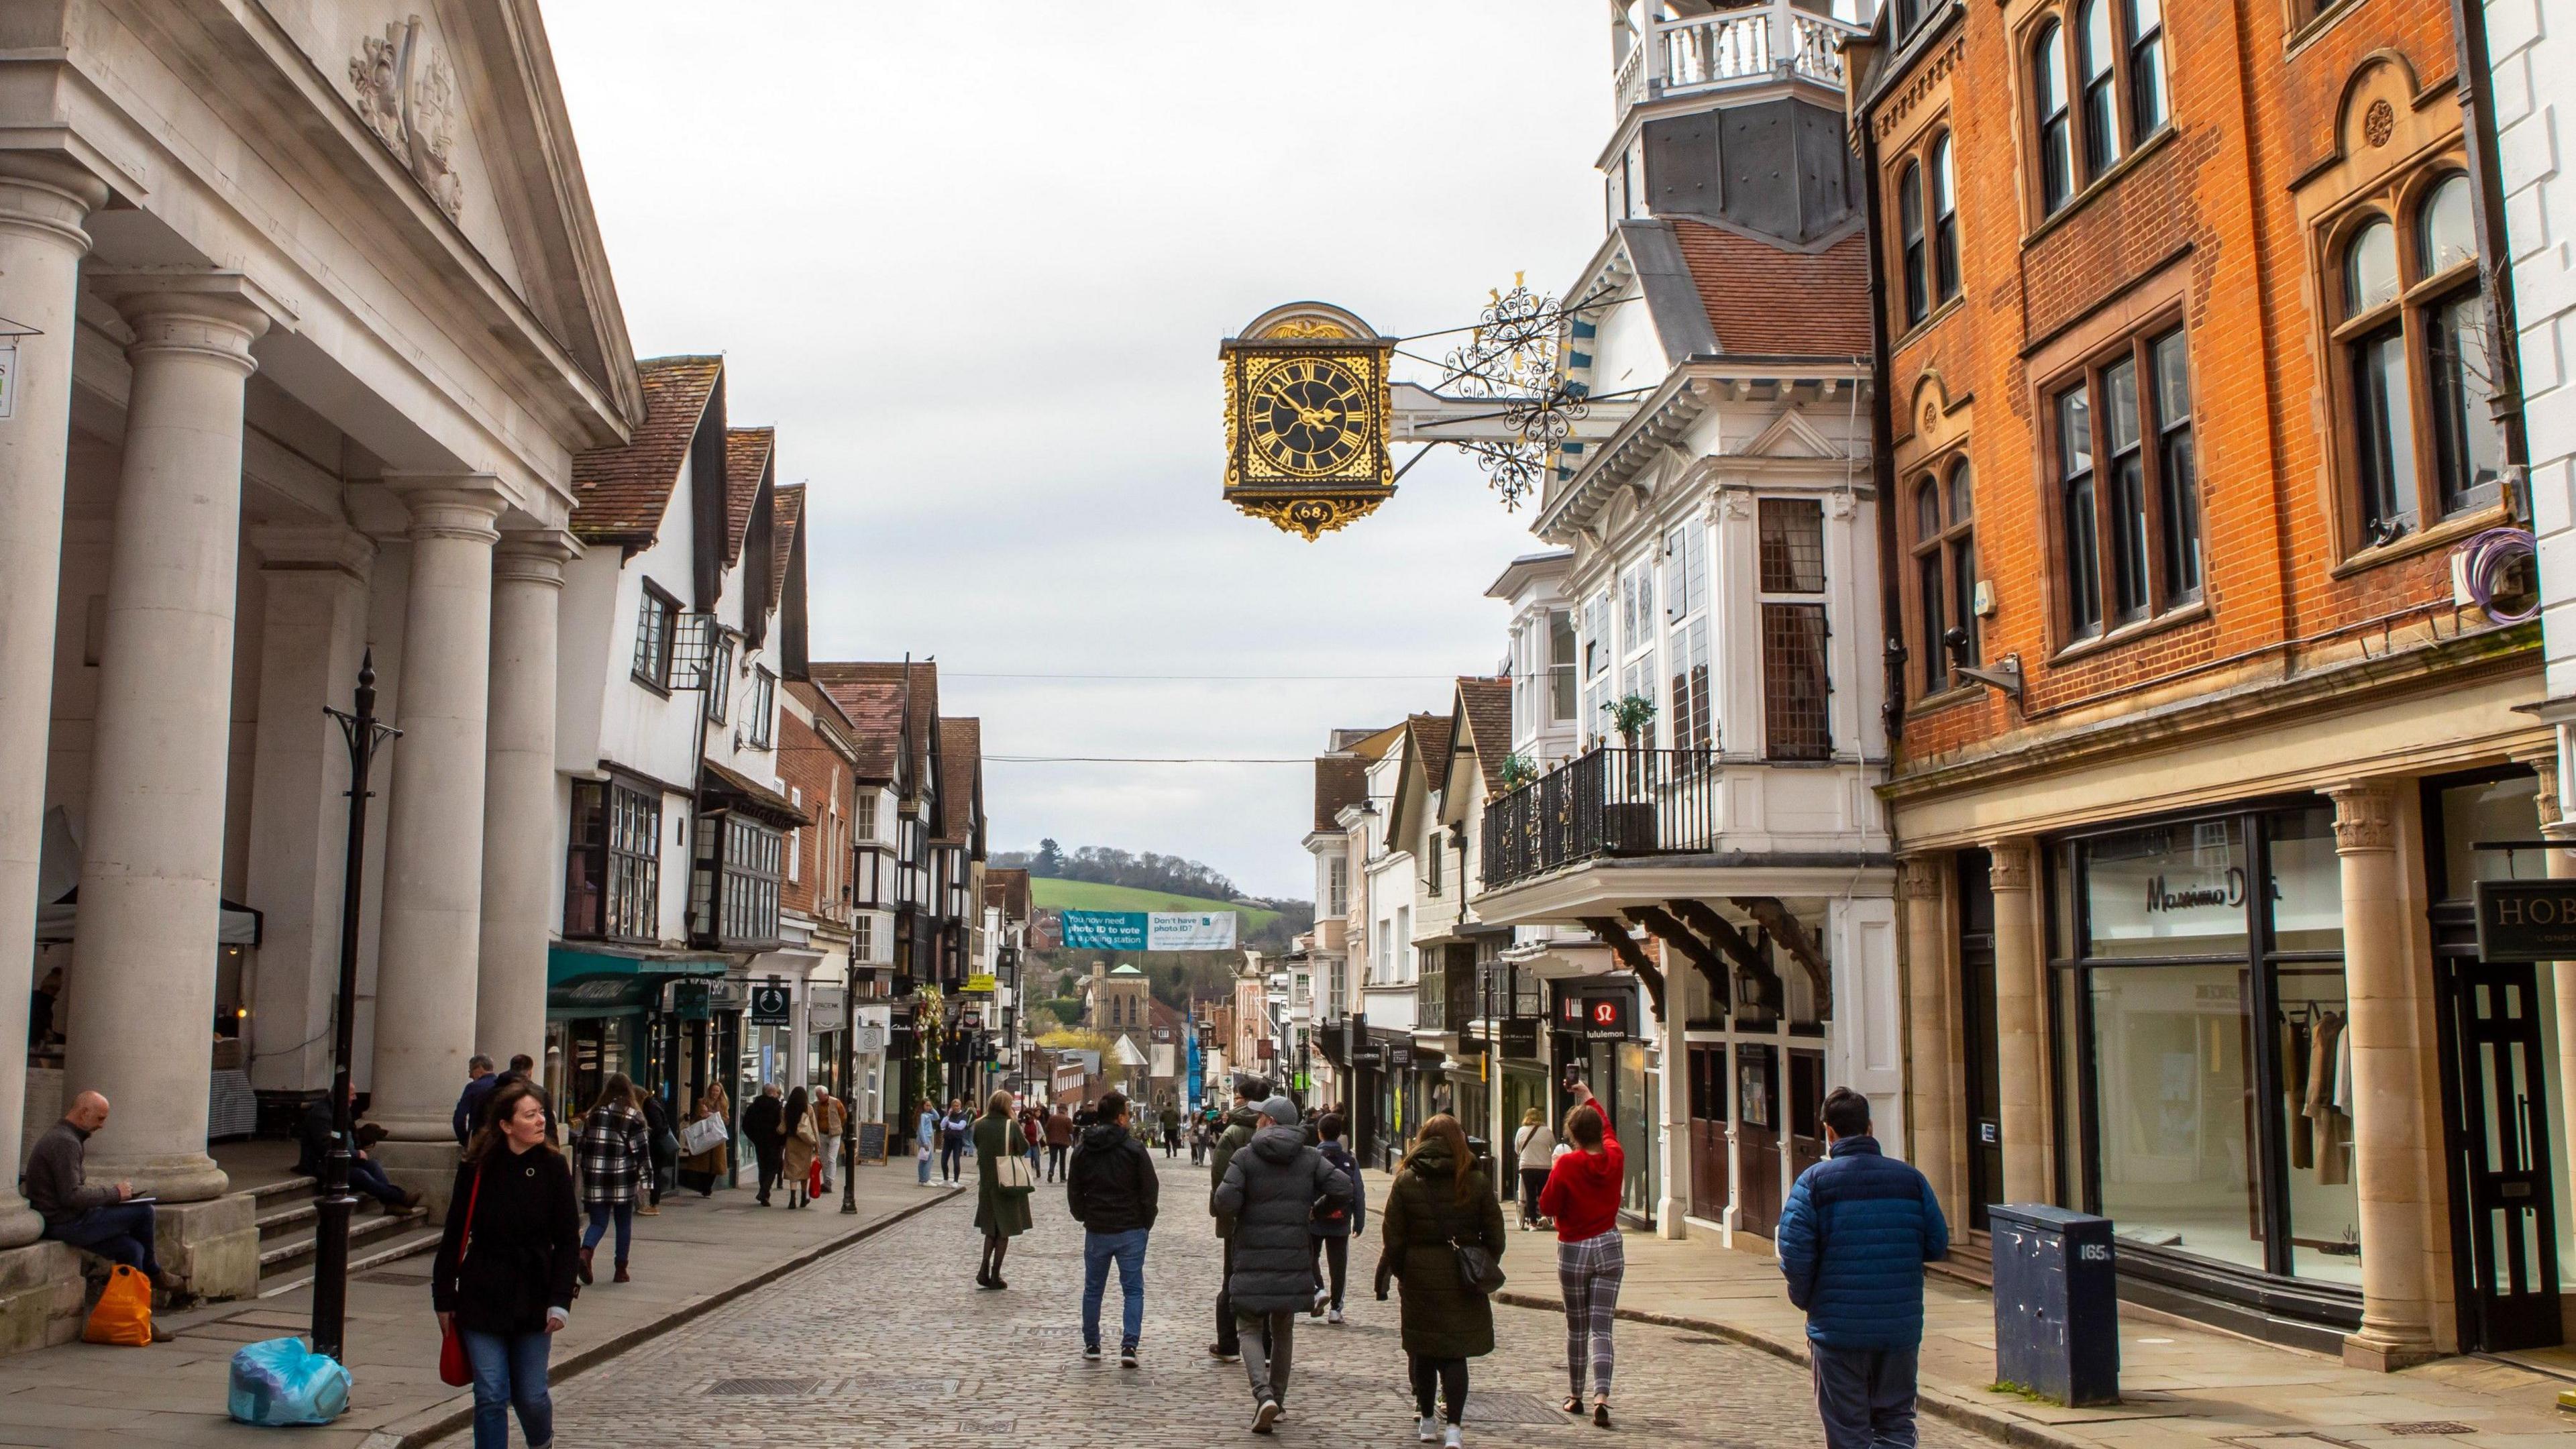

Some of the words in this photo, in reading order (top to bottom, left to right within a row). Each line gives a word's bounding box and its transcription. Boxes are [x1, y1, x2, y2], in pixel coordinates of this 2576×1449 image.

[1295, 506, 1328, 521] 1683
[2147, 875, 2226, 913] Massimo
[1068, 915, 1084, 924] You
[1105, 916, 1125, 924] need
[1068, 924, 1094, 934] photo
[1154, 924, 1178, 933] photo
[1084, 934, 1112, 945] polling
[891, 1023, 911, 1031] Clarks
[1587, 1030, 1625, 1038] lululemon
